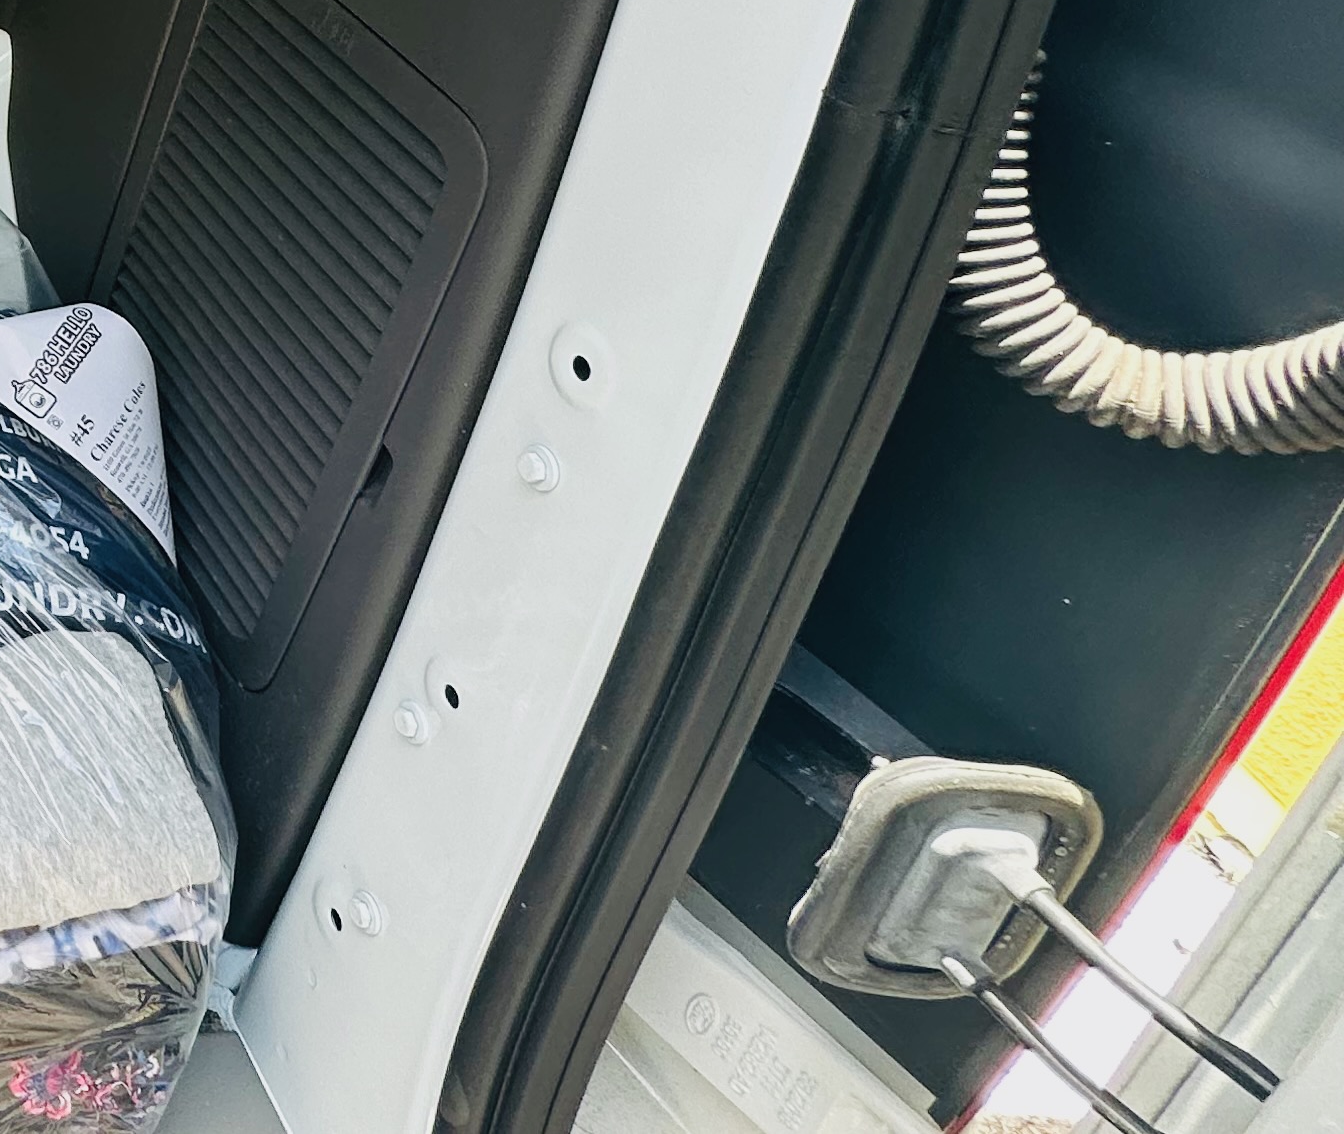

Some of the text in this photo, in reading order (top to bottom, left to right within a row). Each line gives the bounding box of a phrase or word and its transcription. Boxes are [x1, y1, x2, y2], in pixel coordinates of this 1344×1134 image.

[29, 306, 93, 385] 786 HELLO
[54, 322, 103, 385] LAUNDRY
[69, 414, 96, 447] #45
[90, 413, 129, 462] Charese
[123, 380, 147, 413] Coles
